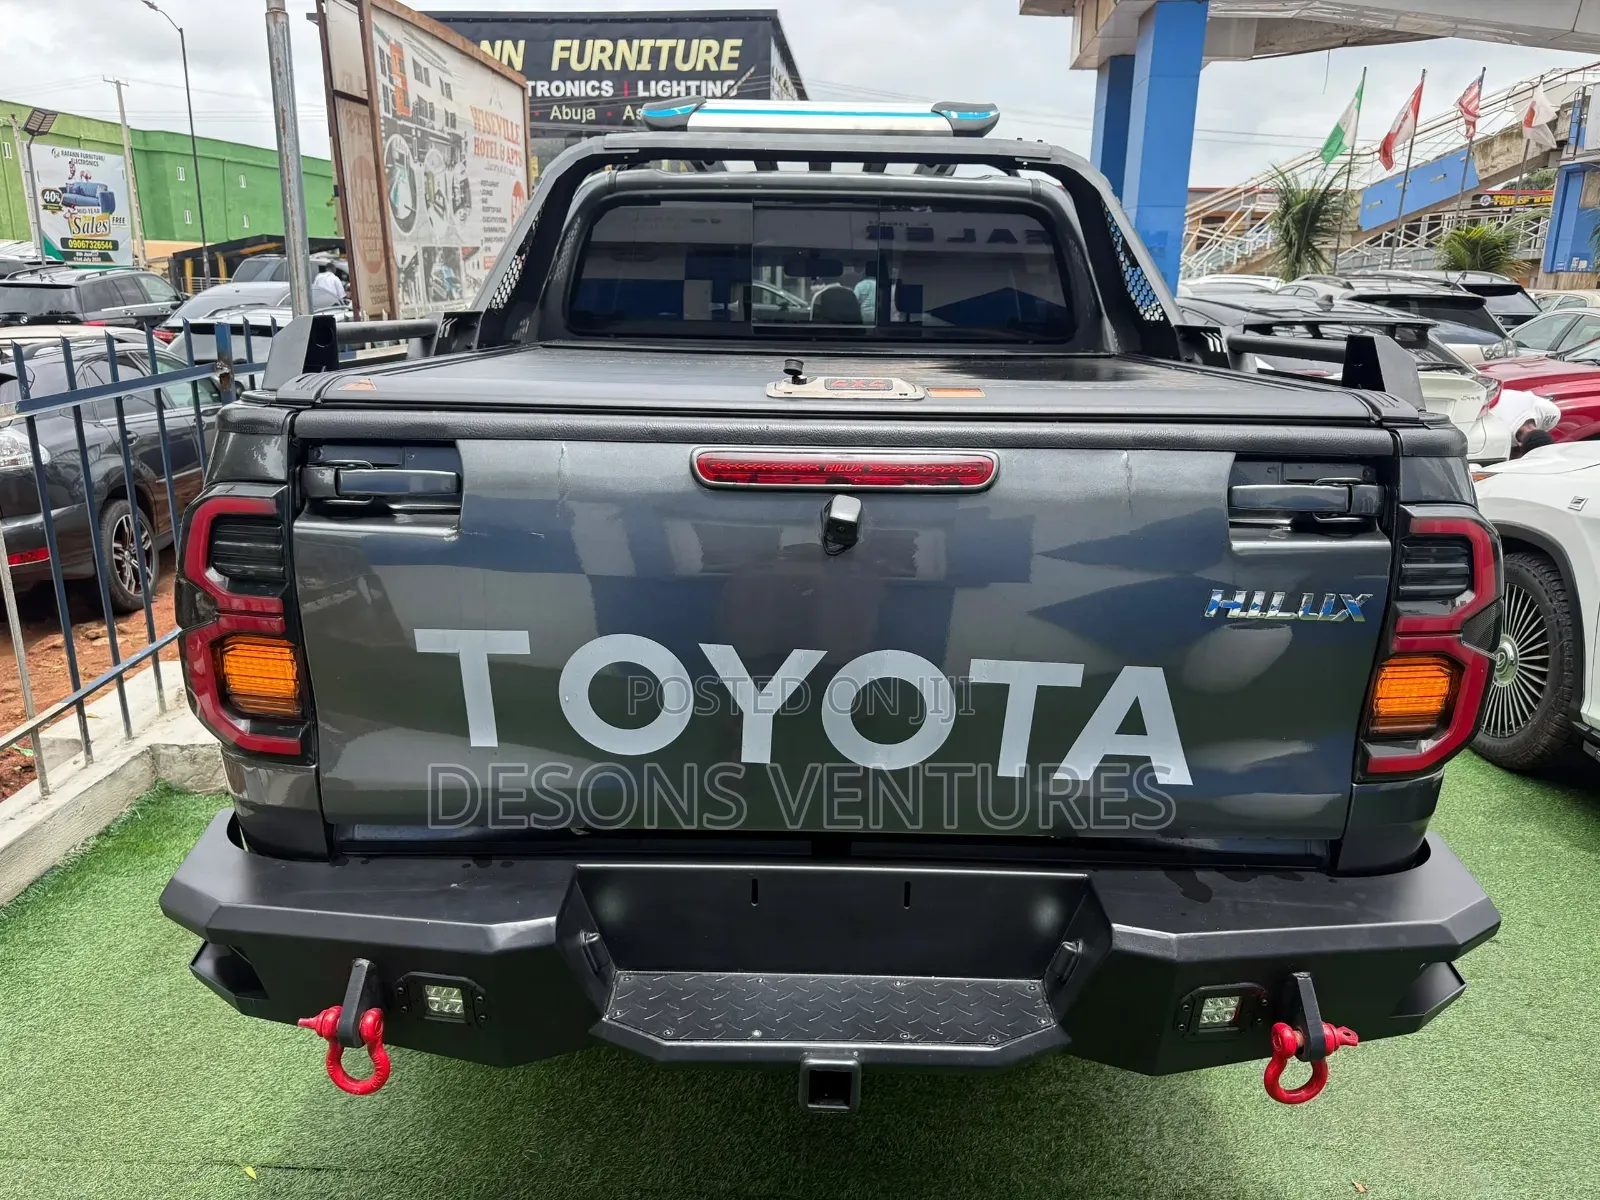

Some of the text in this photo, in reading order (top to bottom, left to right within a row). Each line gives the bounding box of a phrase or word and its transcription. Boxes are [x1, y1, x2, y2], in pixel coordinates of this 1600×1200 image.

[551, 39, 743, 72] FURNITURE
[637, 80, 738, 97] LIGHTING
[550, 105, 596, 123] Abuja
[470, 104, 521, 146] WISEVILLE
[474, 136, 499, 160] HOTEL
[73, 216, 108, 235] Sales
[112, 216, 126, 224] FREE
[68, 240, 113, 250] 09067326544
[823, 463, 865, 473] HILUX
[1205, 588, 1374, 622] HILUX
[414, 628, 1194, 787] TOYOTA
